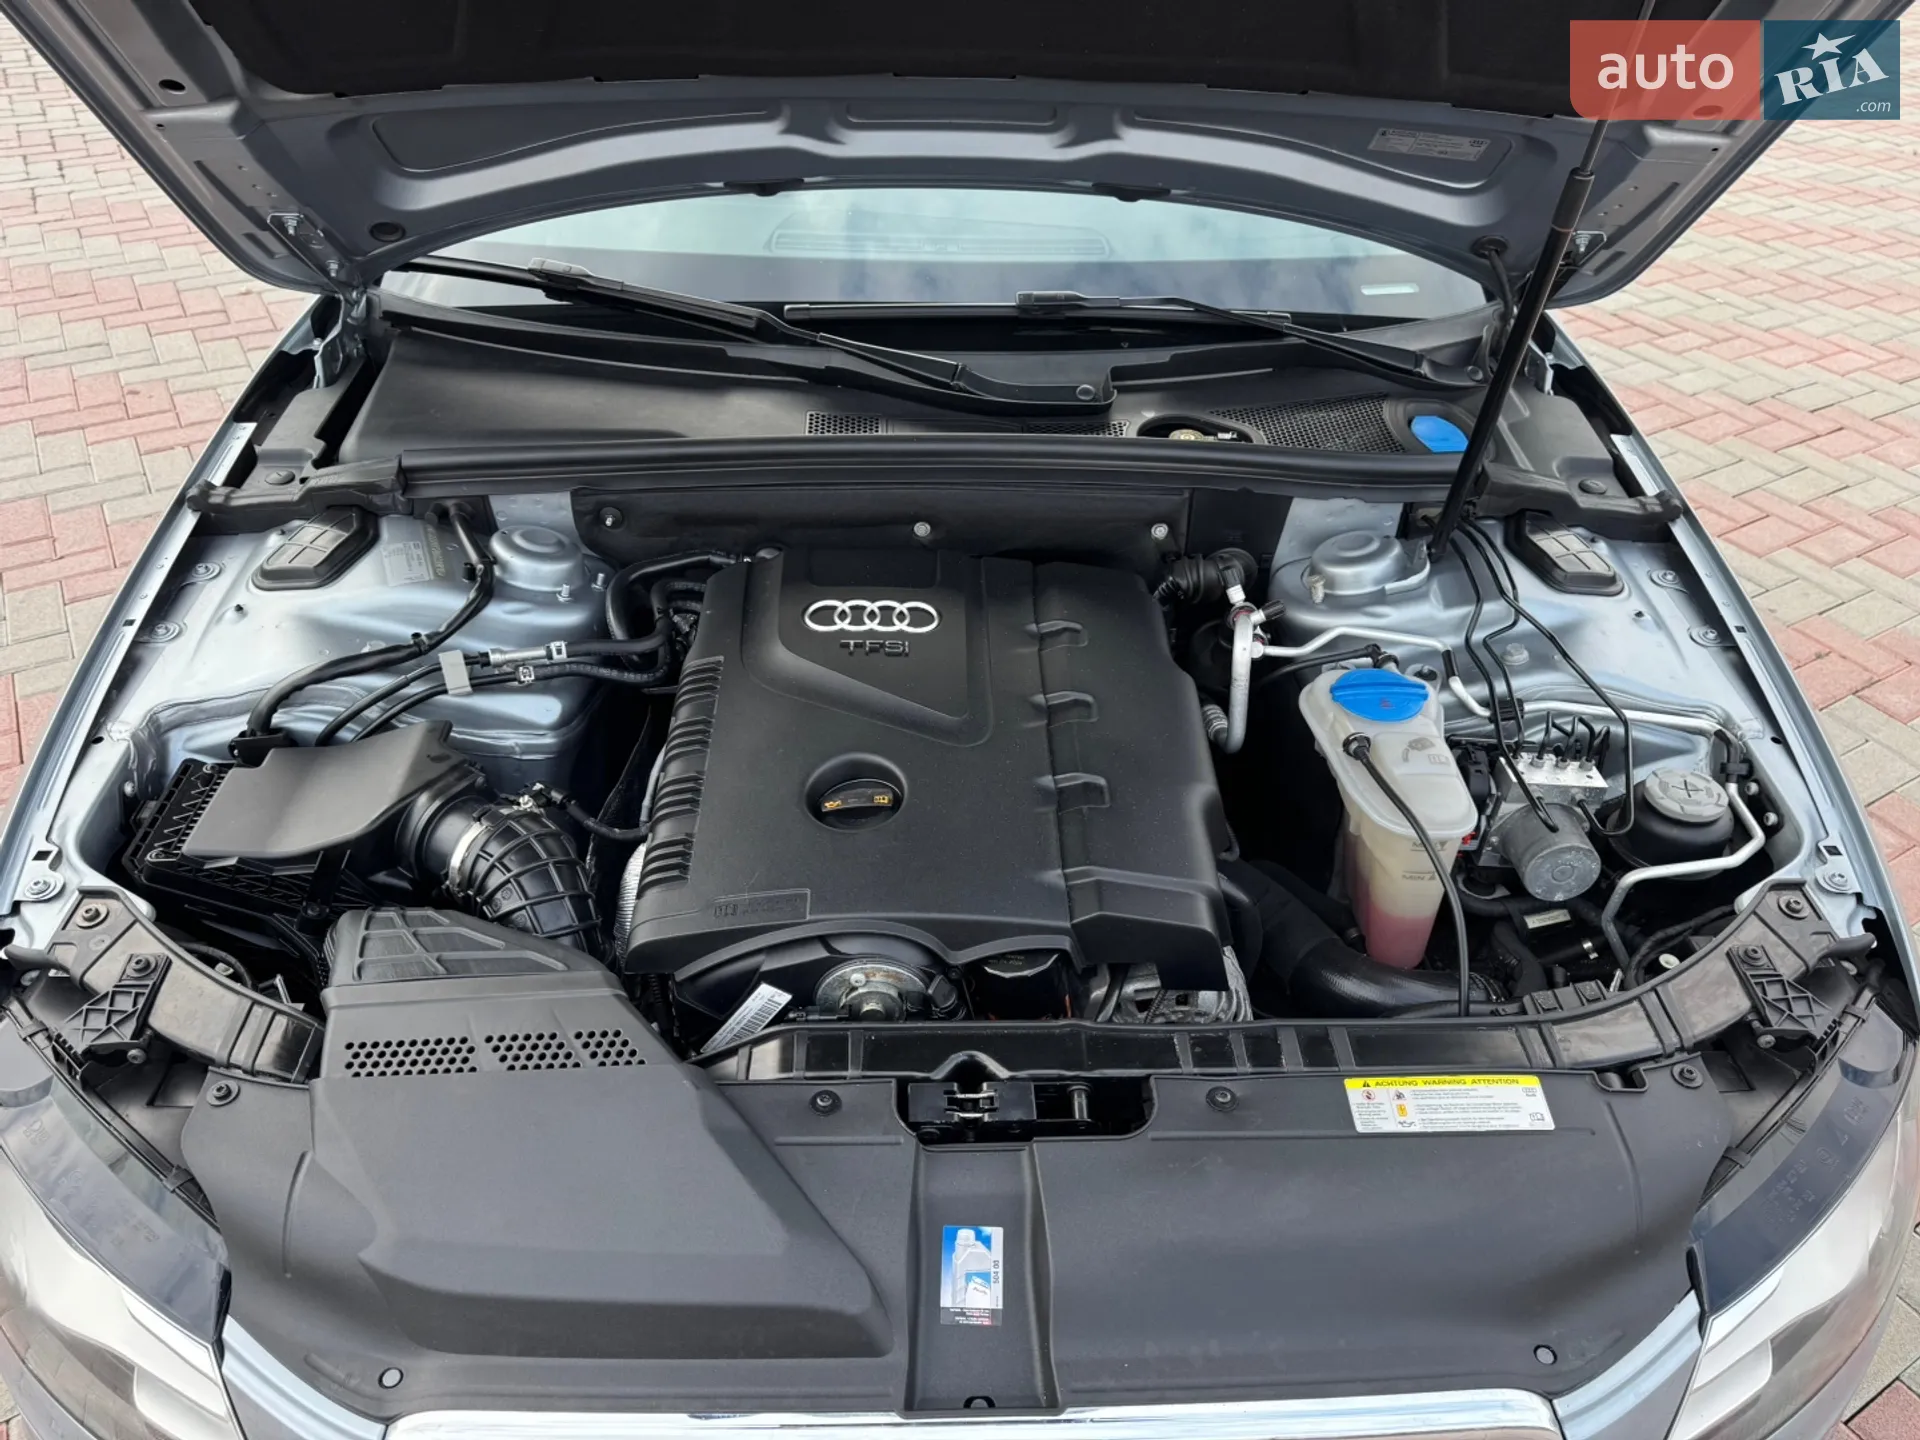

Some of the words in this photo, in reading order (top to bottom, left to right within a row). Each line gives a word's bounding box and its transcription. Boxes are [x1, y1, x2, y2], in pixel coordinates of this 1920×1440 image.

[840, 640, 910, 656] TFSI
[1375, 1079, 1418, 1087] ACHTUNG
[1423, 1078, 1466, 1086] WARNING
